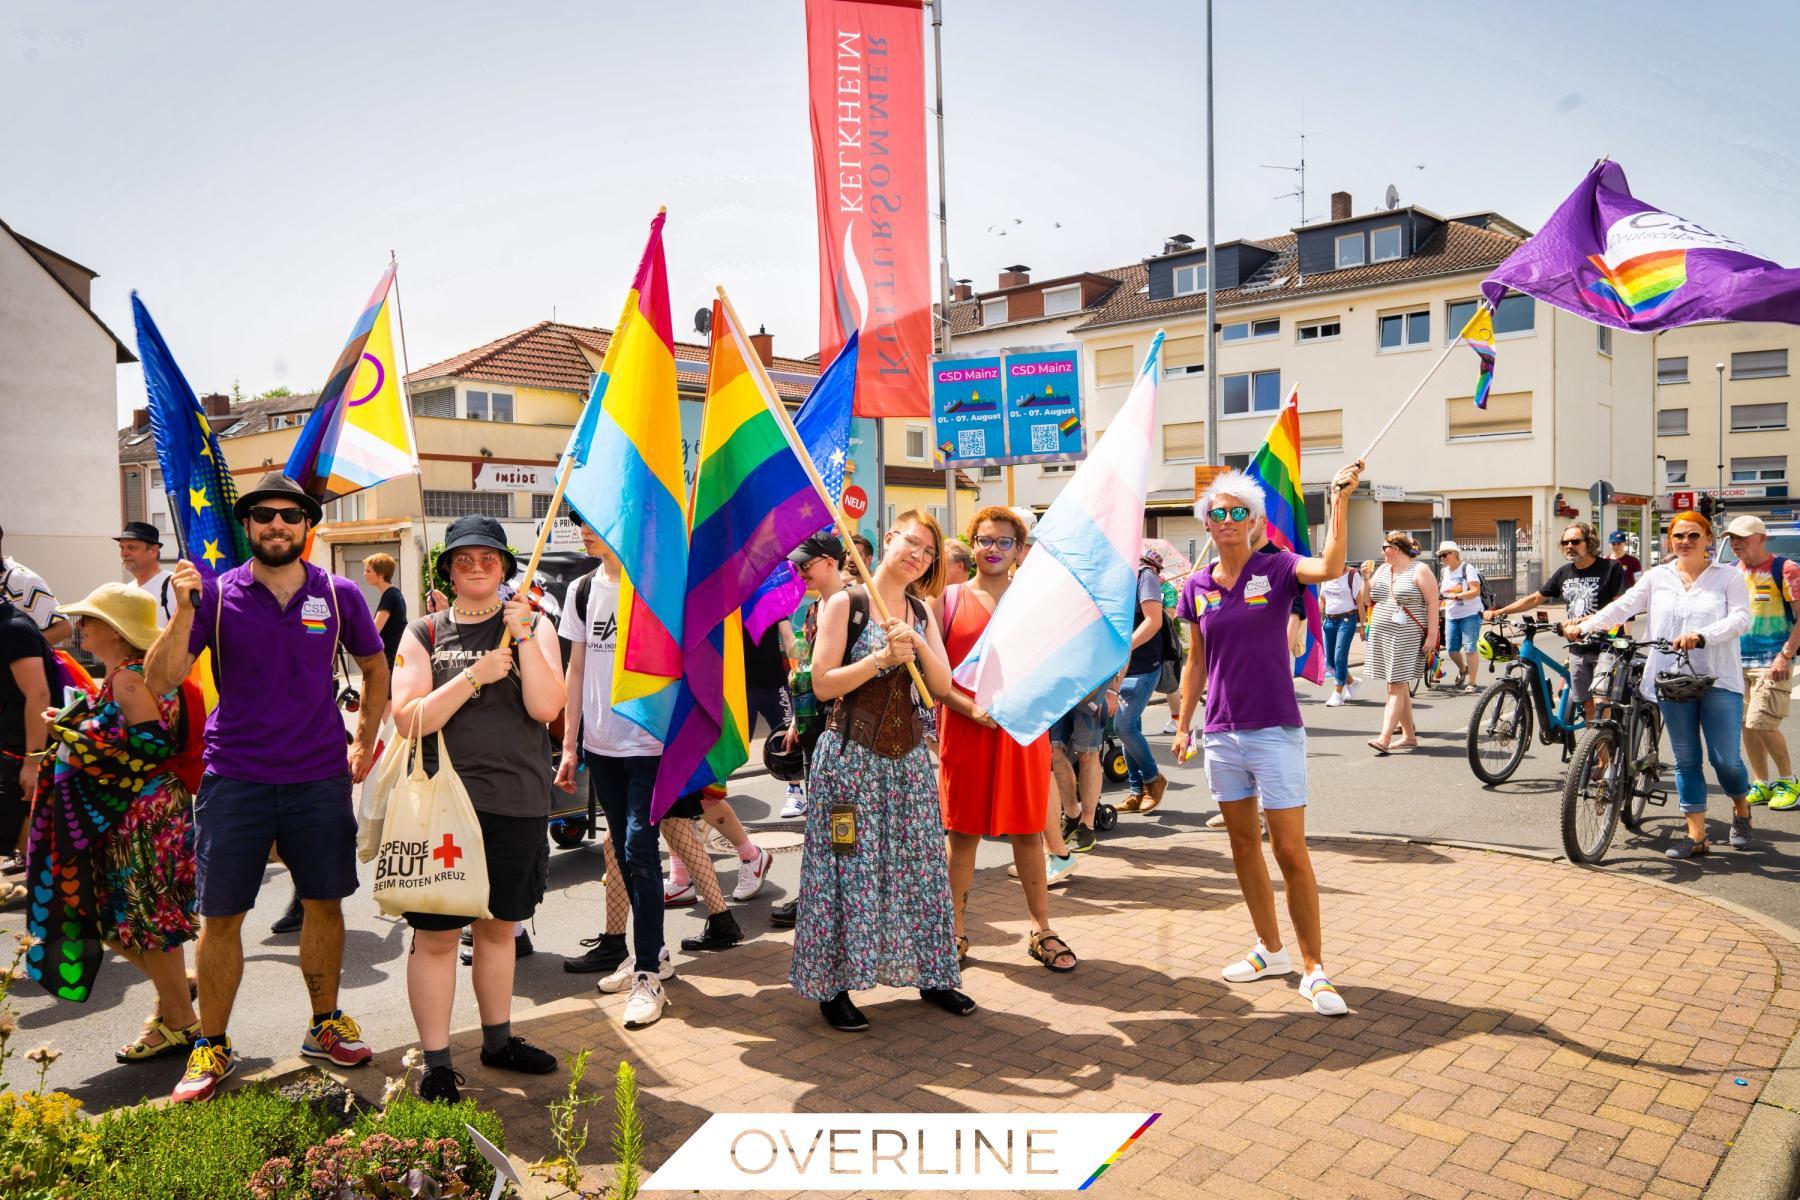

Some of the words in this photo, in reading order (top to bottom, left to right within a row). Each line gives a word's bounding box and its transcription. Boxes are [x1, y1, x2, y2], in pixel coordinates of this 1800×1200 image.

[939, 371, 962, 382] CSD
[965, 368, 998, 380] Mainz
[1011, 365, 1035, 376] CSD
[1038, 362, 1072, 373] Mainz
[970, 413, 1001, 422] August
[1044, 407, 1076, 416] August
[844, 494, 866, 511] NEU!
[304, 603, 328, 613] CSD
[380, 840, 429, 858] SPENDE
[376, 855, 428, 880] BLUT
[374, 879, 395, 892] BEIM
[399, 876, 431, 889] ROTEN
[434, 871, 466, 882] KREUZ
